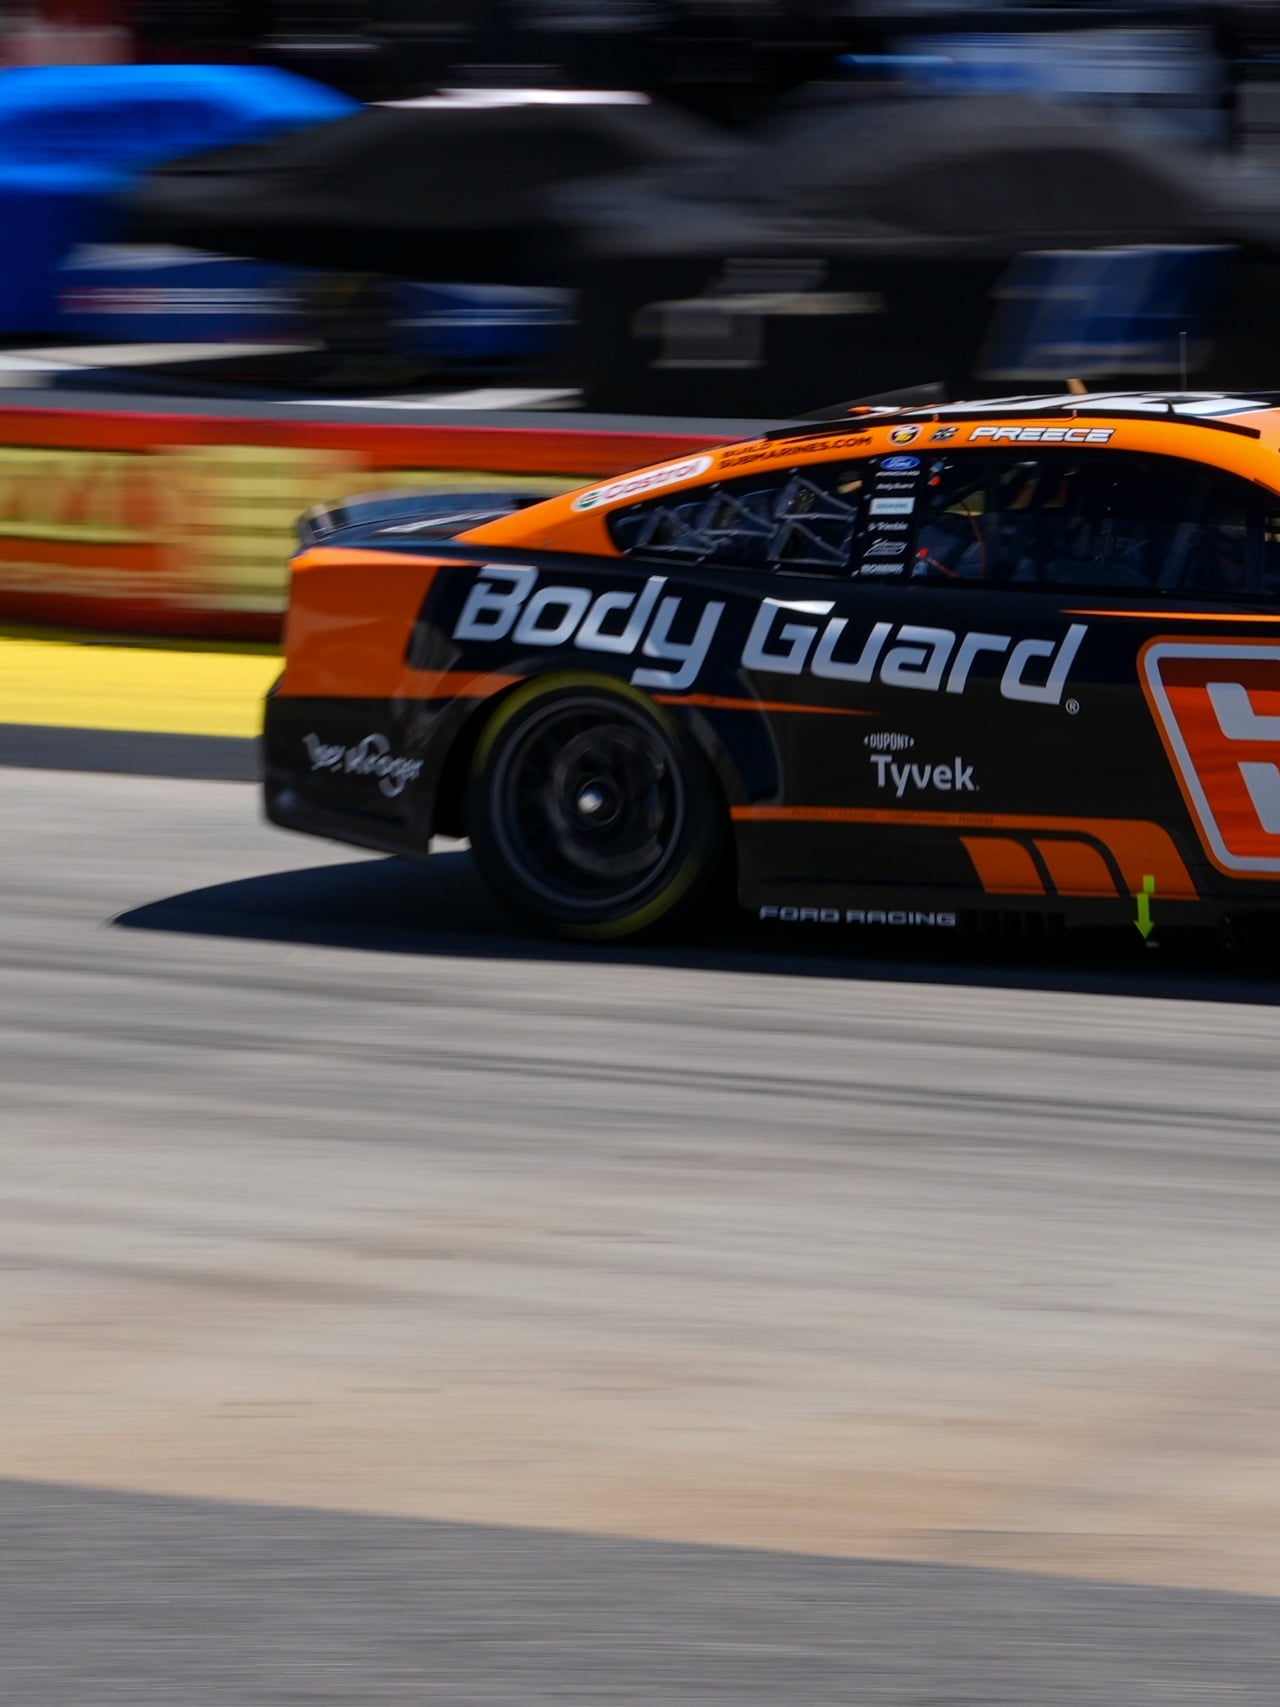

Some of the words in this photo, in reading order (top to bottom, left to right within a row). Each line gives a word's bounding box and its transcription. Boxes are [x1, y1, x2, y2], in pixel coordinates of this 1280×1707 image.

[968, 426, 1116, 443] PREECE
[718, 436, 874, 470] SUBMARINES.COM
[600, 461, 700, 499] Castrol
[453, 564, 726, 690] Body
[741, 597, 1088, 705] Guard
[869, 732, 910, 751] DUPONT
[870, 754, 976, 798] Tyvek
[759, 905, 841, 923] FORD
[846, 909, 957, 927] RACING
